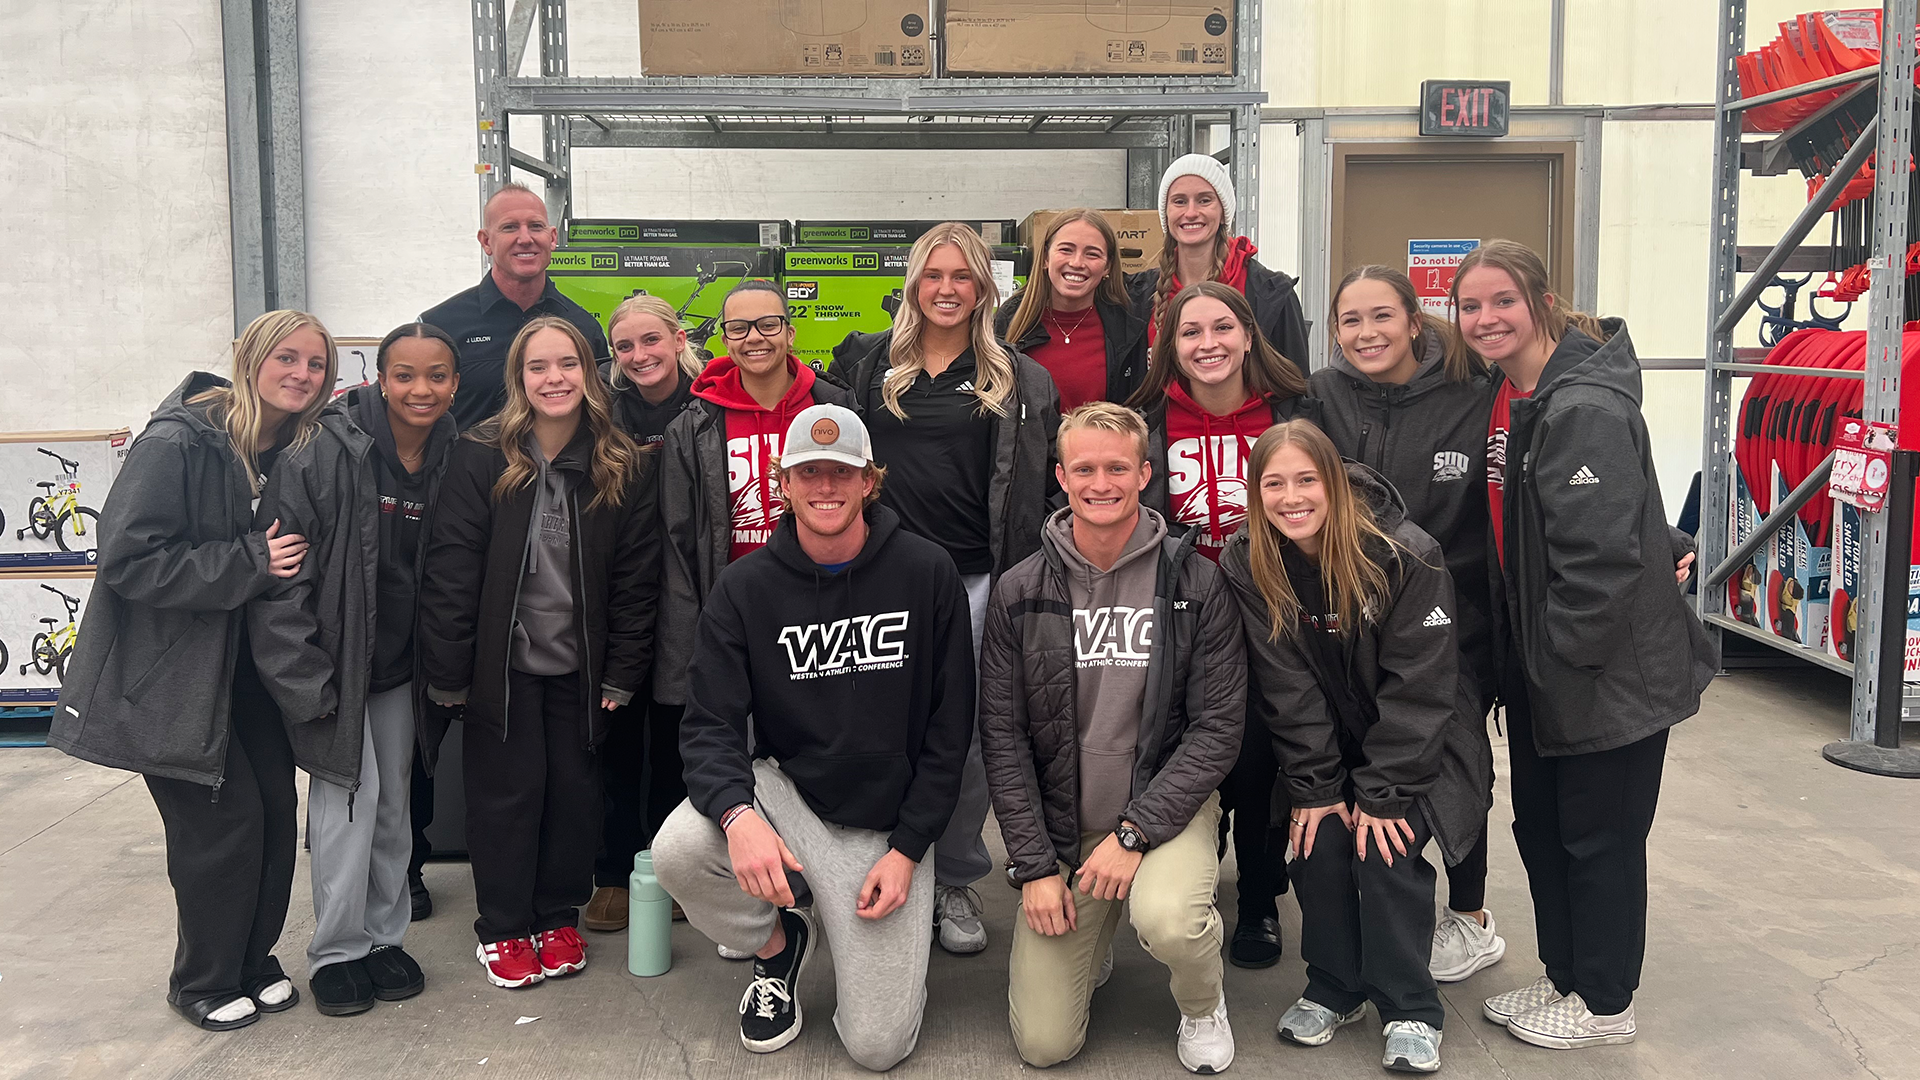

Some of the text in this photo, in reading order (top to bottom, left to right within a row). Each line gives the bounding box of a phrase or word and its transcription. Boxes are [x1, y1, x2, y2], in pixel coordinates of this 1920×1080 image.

[1440, 87, 1494, 127] EXIT
[571, 228, 636, 237] greenworks pro
[803, 228, 867, 238] greenworks pro
[551, 255, 614, 267] nworks pro
[790, 255, 875, 267] greenworks pro
[1413, 256, 1462, 265] Do not blo
[1423, 298, 1442, 307] Fire
[1433, 451, 1470, 473] SUU
[1568, 477, 1600, 486] adidas
[58, 488, 81, 496] Y7341
[1786, 524, 1794, 556] FOAM
[1844, 521, 1852, 586] SNOW SLED
[1852, 540, 1860, 574] FOAM
[1422, 617, 1452, 627] adidas
[777, 610, 910, 673] WAC
[858, 660, 904, 672] CONFERENCE
[1115, 659, 1149, 667] CONFER
